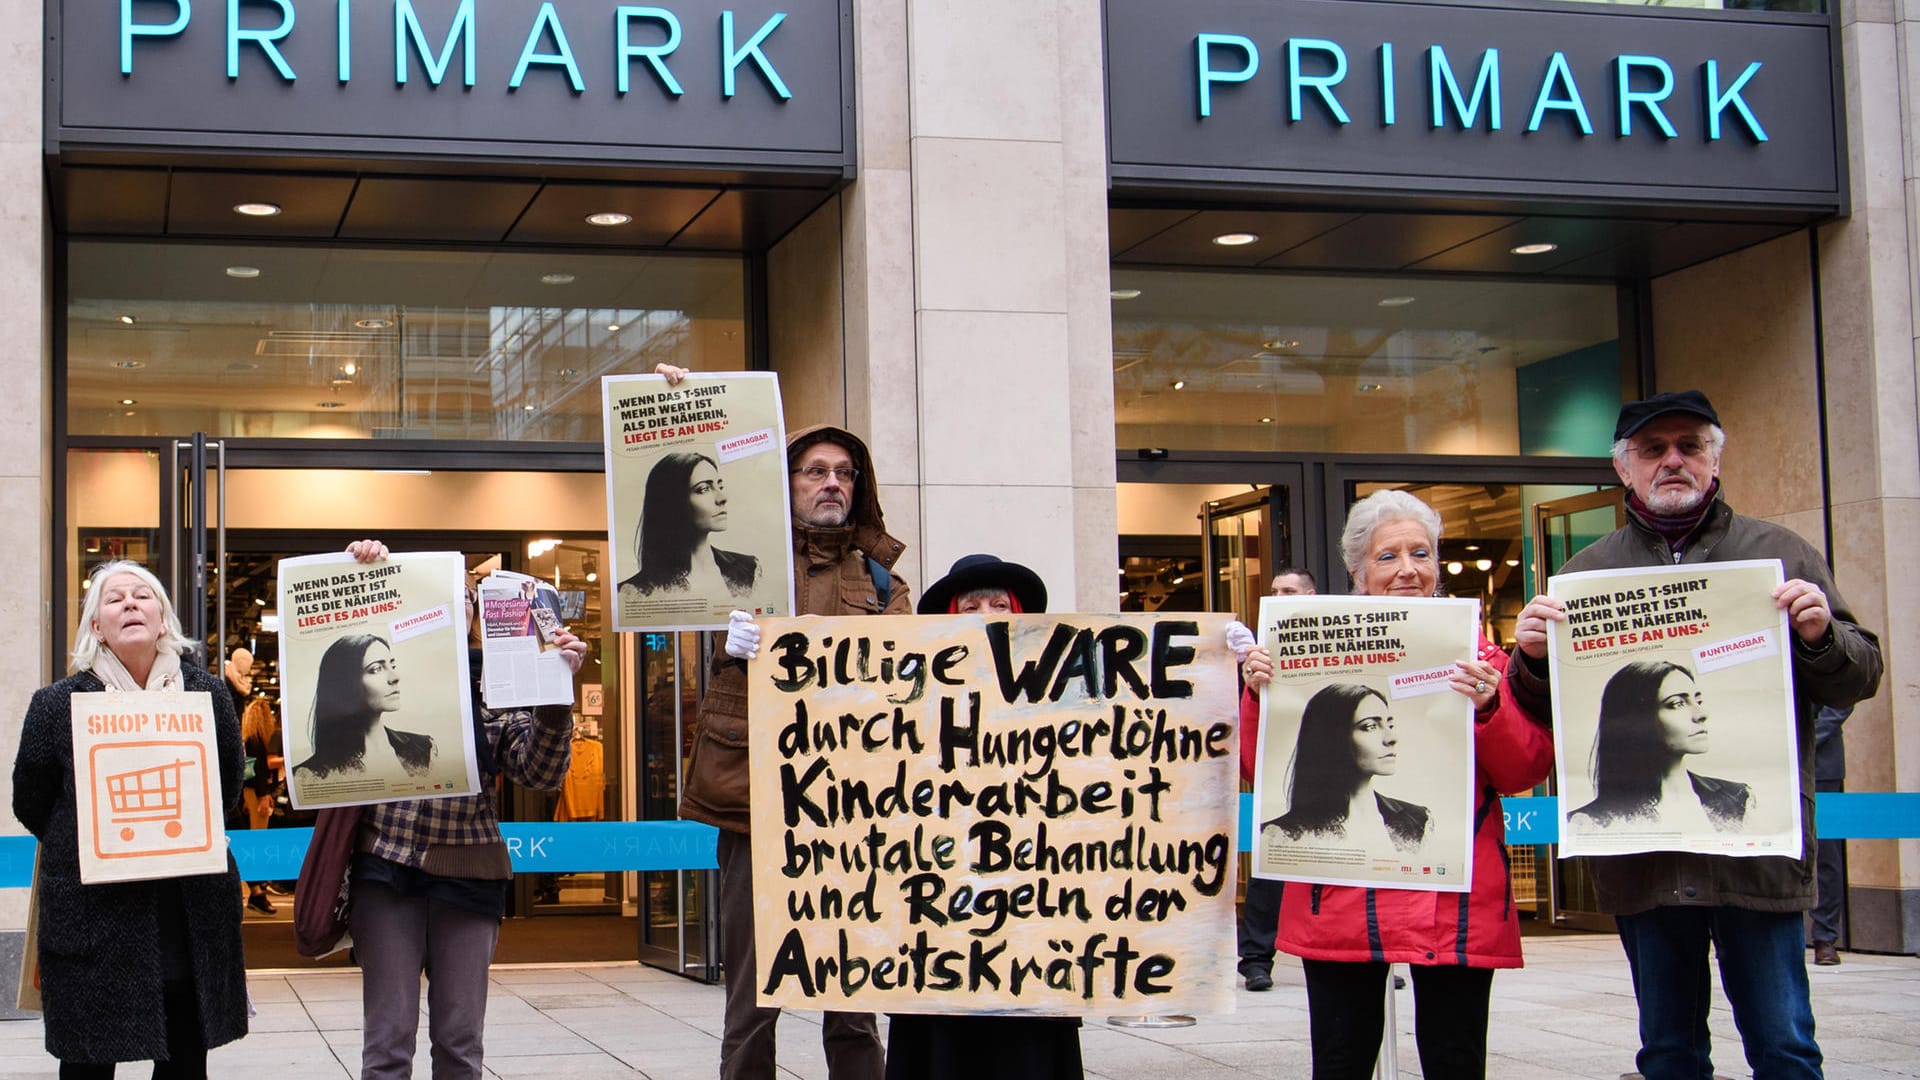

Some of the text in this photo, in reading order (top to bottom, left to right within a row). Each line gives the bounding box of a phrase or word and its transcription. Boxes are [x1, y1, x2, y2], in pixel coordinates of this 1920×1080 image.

[121, 0, 793, 98] PRIMARK
[1194, 33, 1768, 141] PRIMARK
[657, 391, 681, 402] DAS
[683, 385, 727, 400] T-SHIRT
[620, 398, 713, 421] MEHR WERT IST
[623, 409, 727, 433] ALS DIE NÄHERIN,
[624, 431, 657, 445] LIEGT
[660, 428, 675, 439] ES
[677, 424, 695, 437] AN
[721, 433, 769, 451] #UNTRAGBAR
[331, 573, 356, 586] DAS
[357, 565, 402, 582] T-SHIRT
[294, 580, 387, 604] MEHR WERT IST
[297, 589, 401, 616] ALS DIE NÄHERIN,
[1614, 588, 1646, 603] DAS
[1648, 578, 1709, 598] T-SHIRT
[297, 614, 331, 628] LIEGT
[334, 611, 349, 622] ES
[351, 607, 369, 619] AN
[394, 609, 444, 631] #UNTRAGBAR
[501, 608, 527, 619] Fashion
[1322, 614, 1350, 627] DAS
[1353, 610, 1409, 625] T-SHIRT
[1567, 596, 1688, 624] MEHR WERT IST
[1278, 625, 1389, 643] MEHR WERT IST
[1571, 608, 1707, 639] ALS DIE NÄHERIN,
[1280, 637, 1405, 657] ALS DIE NÄHERIN,
[1573, 636, 1616, 652] LIEGT
[1619, 632, 1638, 645] ES
[1641, 627, 1664, 642] AN
[1700, 635, 1765, 659] #UNTRAGBAR
[770, 621, 1200, 704] Billige WARE
[1280, 658, 1319, 671] LIEGT
[1323, 656, 1339, 667] ES
[1343, 654, 1364, 666] AN
[87, 712, 204, 735] SHOP FAIR
[778, 691, 1233, 781] durch Hungerlöhne
[780, 756, 1172, 828] Kinderarbeit
[781, 820, 1230, 896] brutale Behandlung
[787, 868, 1187, 937] und Regeln der
